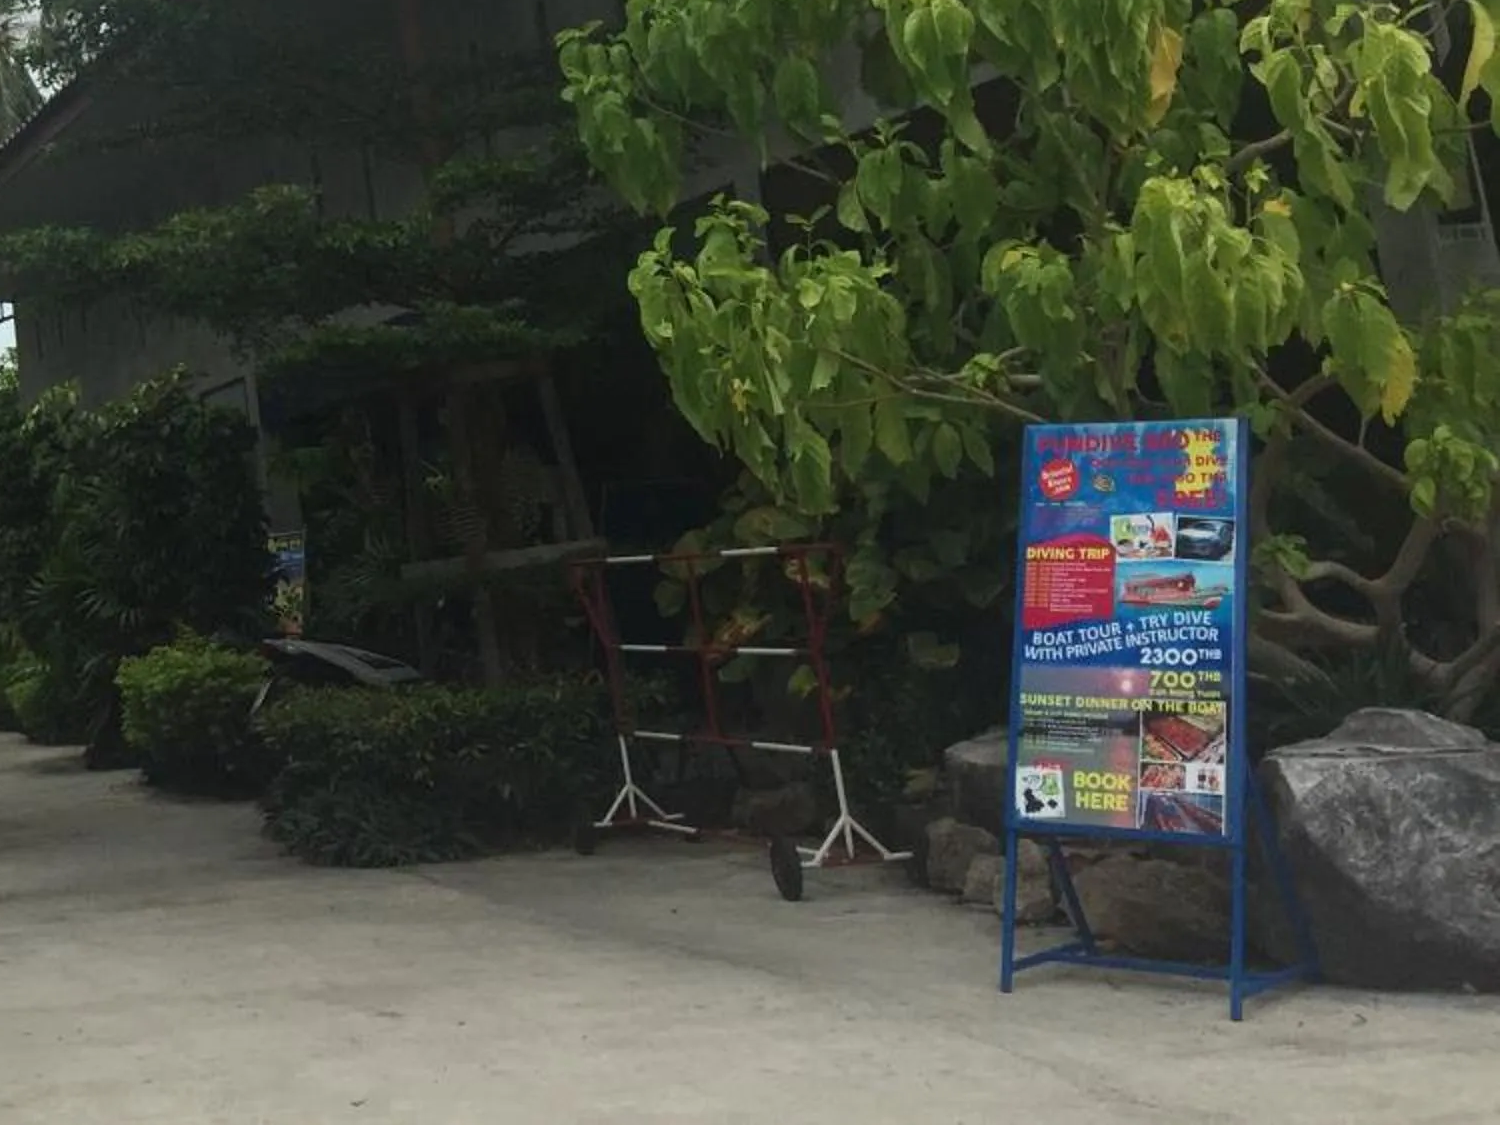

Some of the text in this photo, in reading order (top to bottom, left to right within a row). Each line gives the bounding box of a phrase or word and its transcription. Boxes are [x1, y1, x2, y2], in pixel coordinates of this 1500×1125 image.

[1027, 546, 1110, 561] DIVING TRIP
[1033, 630, 1074, 646] BOAT
[1078, 622, 1121, 642] TOUR
[1139, 613, 1169, 630] TRY
[1174, 610, 1213, 626] DIVE
[1025, 626, 1219, 660] WITH PRIVATE INSTRUCTOR
[1140, 647, 1198, 665] 2300
[1151, 671, 1196, 688] 700
[1020, 692, 1071, 707] SUNSET
[1076, 695, 1128, 710] DINNER
[1131, 698, 1152, 711] ON
[1156, 700, 1184, 712] THE
[1073, 771, 1131, 791] BOOK
[1076, 792, 1129, 812] HERE
